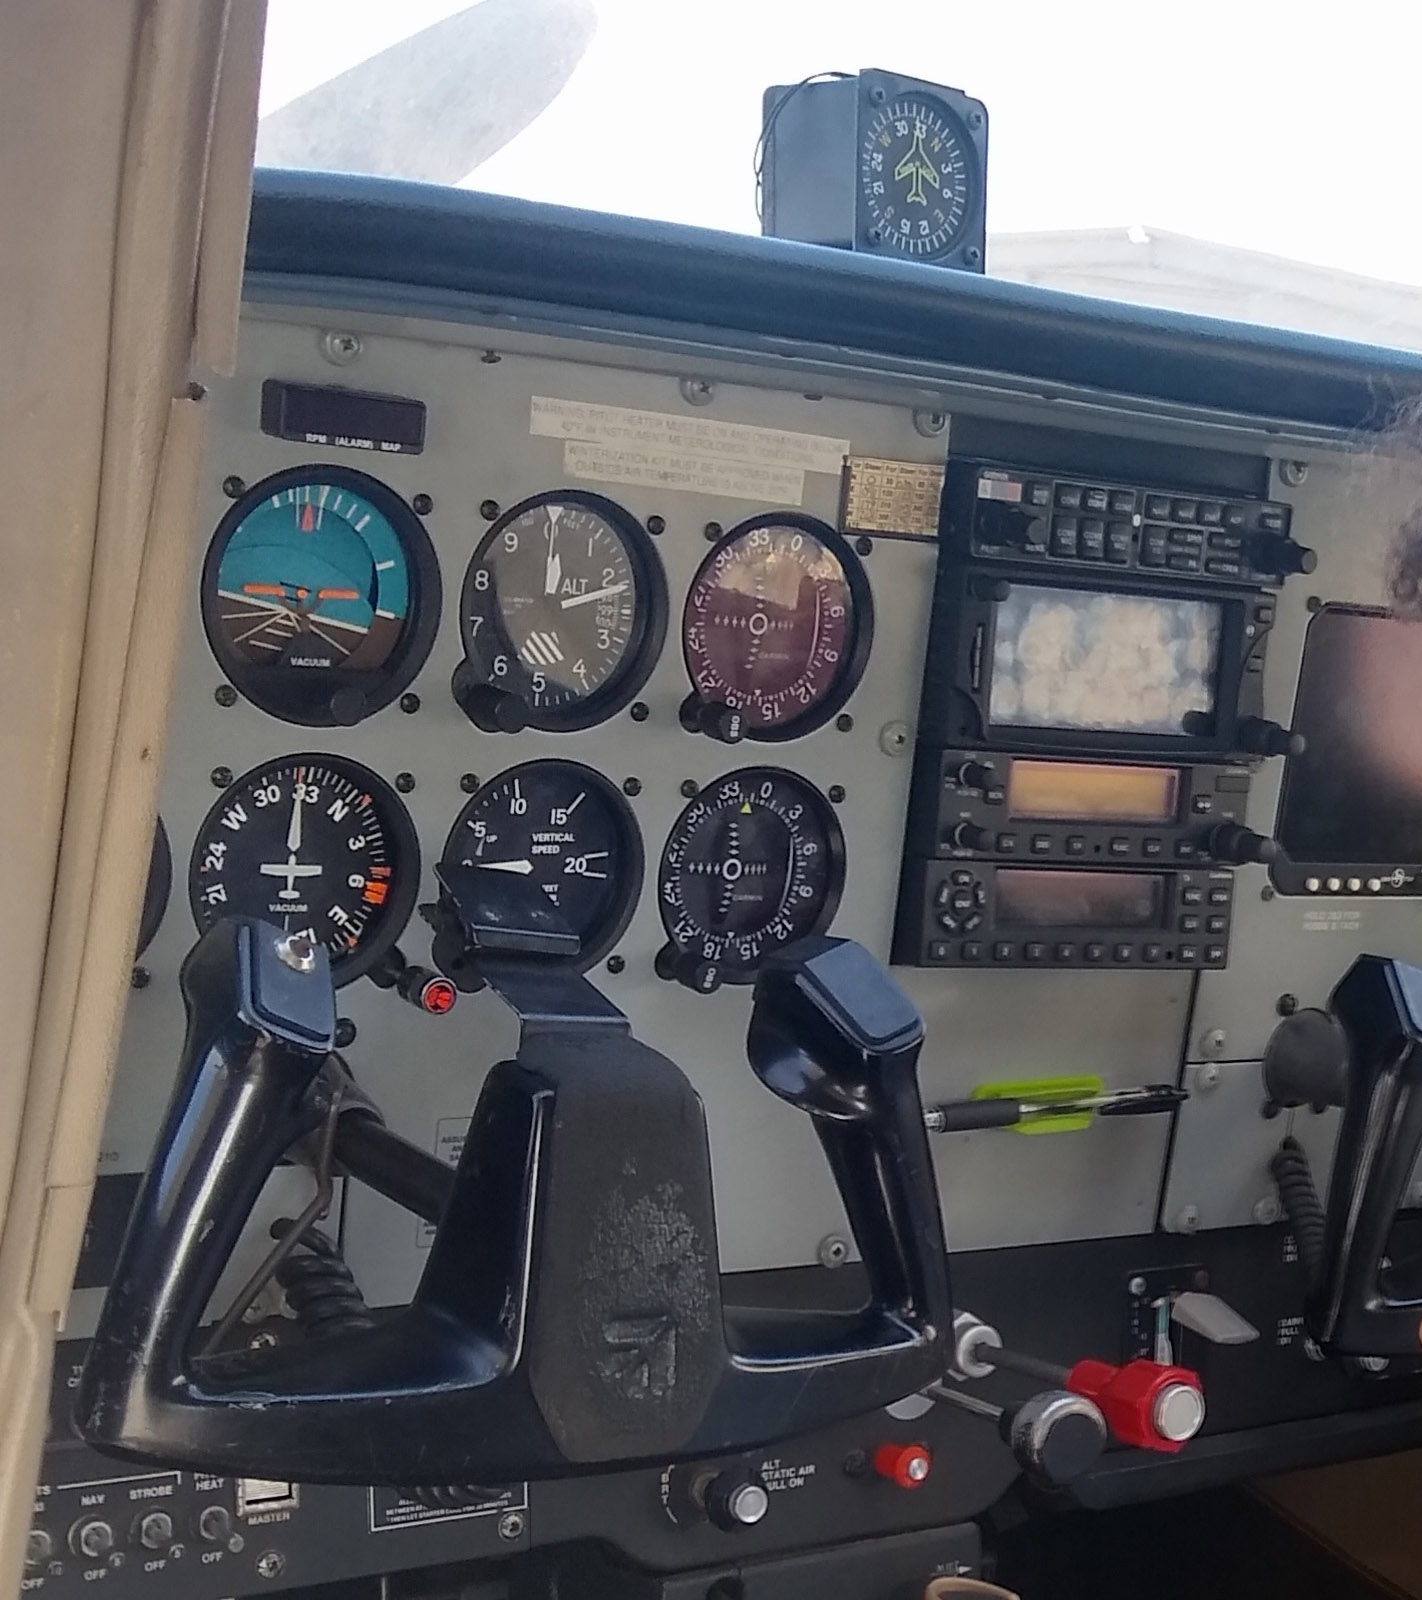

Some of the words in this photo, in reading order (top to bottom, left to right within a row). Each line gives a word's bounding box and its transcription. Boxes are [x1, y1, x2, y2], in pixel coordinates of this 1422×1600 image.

[894, 120, 908, 136] 30
[879, 131, 892, 148] W
[930, 135, 943, 153] N
[871, 152, 883, 171] 24
[941, 162, 952, 173] 3
[942, 188, 953, 199] 6
[305, 433, 327, 444] RPM
[381, 441, 401, 452] MAP
[504, 532, 518, 553] 9
[748, 528, 770, 547] 33
[790, 535, 803, 551] 0
[587, 537, 594, 557] 1
[715, 547, 733, 566] 30
[475, 570, 489, 591] 8
[561, 577, 589, 595] ALT
[602, 568, 616, 588] 2
[830, 605, 844, 618] 6
[470, 616, 484, 637] 7
[597, 628, 610, 649] 3
[290, 656, 331, 668] VACUUM
[824, 649, 839, 663] 9
[494, 656, 507, 676] 6
[572, 658, 587, 678] 4
[532, 672, 545, 692] 5
[796, 682, 817, 704] 12
[762, 702, 782, 721] 15
[253, 785, 280, 807] 30
[292, 783, 320, 804] 33
[719, 781, 740, 799] 33
[760, 781, 773, 798] 0
[326, 799, 350, 823] N
[509, 799, 528, 815] 10
[687, 802, 705, 823] 30
[789, 804, 803, 820] 3
[220, 803, 248, 831] W
[550, 809, 567, 825] 15
[473, 821, 486, 838] 5
[532, 832, 576, 843] VERTICAL
[348, 834, 366, 851] 3
[486, 834, 498, 843] UP
[205, 840, 227, 871] 24
[531, 844, 560, 855] SPEED
[803, 843, 818, 856] 6
[563, 857, 587, 874] 20
[347, 873, 365, 889] 6
[206, 883, 228, 905] 21
[798, 884, 814, 898] 9
[268, 903, 308, 913] VACUUM
[328, 905, 348, 925] E
[772, 919, 795, 940] 12
[703, 941, 722, 961] 18
[740, 942, 761, 960] 15
[760, 1468, 795, 1481] STATIC
[799, 1465, 816, 1476] AIR
[761, 1459, 781, 1470] ALT
[128, 1485, 174, 1500] STROBE
[196, 1478, 225, 1492] HEAT
[764, 1479, 787, 1491] ULL
[789, 1477, 805, 1488] ON
[80, 1493, 106, 1507] NAV
[248, 1512, 290, 1526] MASTER
[418, 1509, 445, 1519] STARTER
[144, 1559, 167, 1572] OFF
[201, 1551, 224, 1564] OFF
[83, 1568, 108, 1581] OFF
[20, 1577, 45, 1590] OFF
